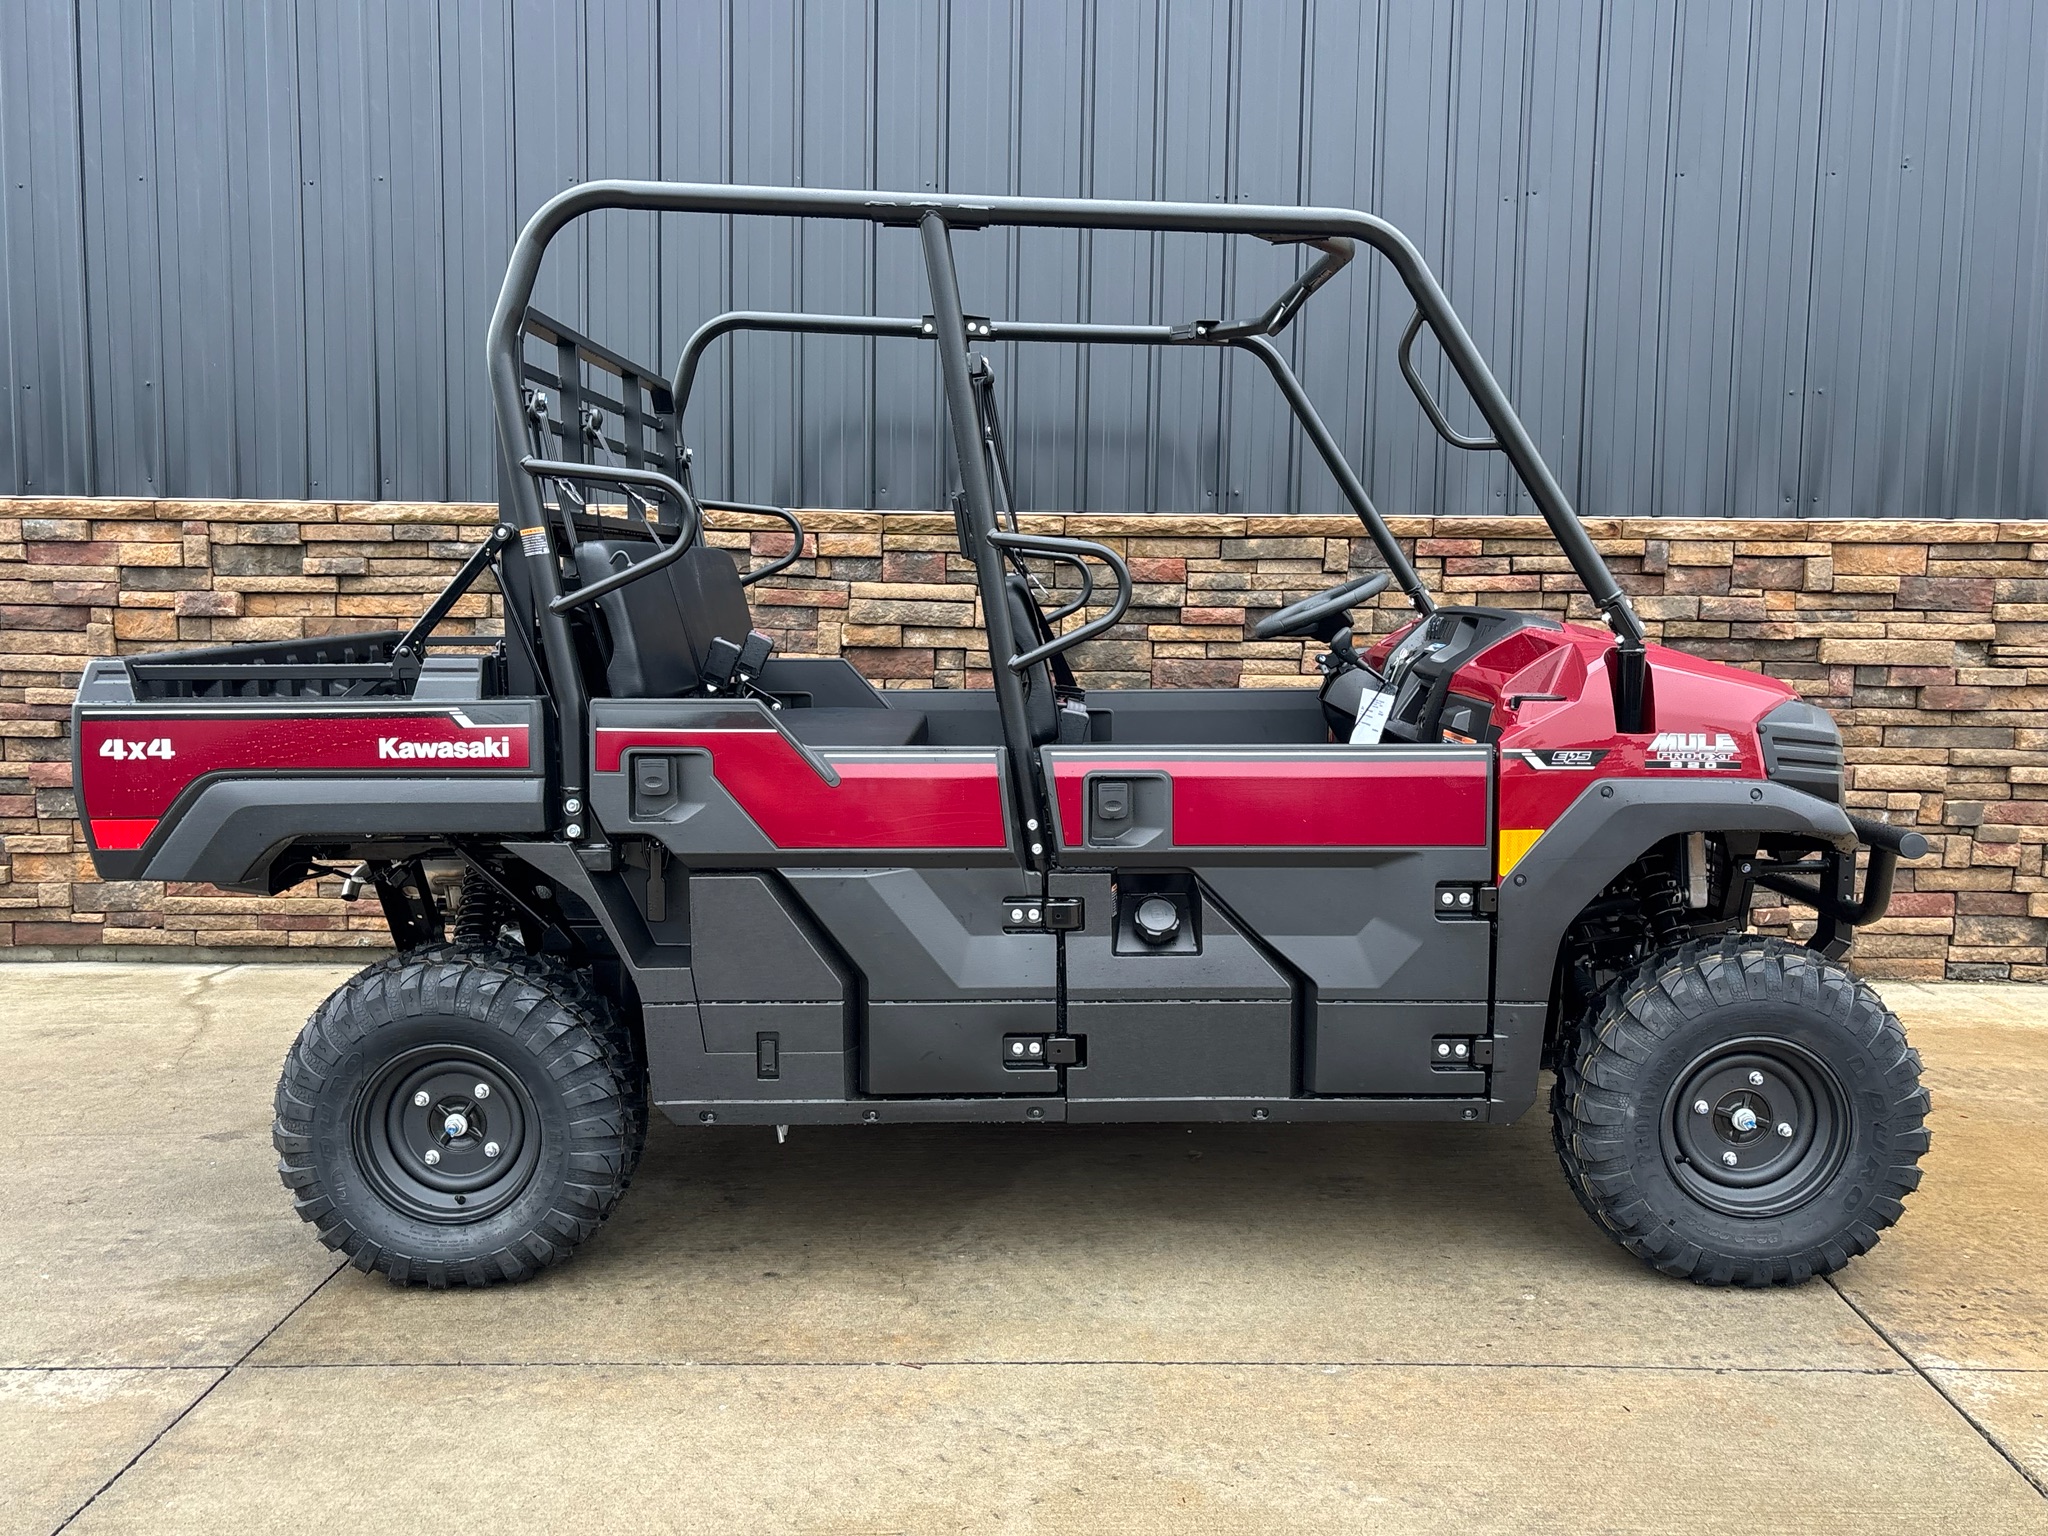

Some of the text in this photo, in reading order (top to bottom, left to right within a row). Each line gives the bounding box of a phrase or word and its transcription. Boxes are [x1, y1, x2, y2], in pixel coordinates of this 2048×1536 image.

[98, 738, 176, 761] 4x4
[377, 736, 510, 760] Kawasaki
[1646, 732, 1741, 752] MULE
